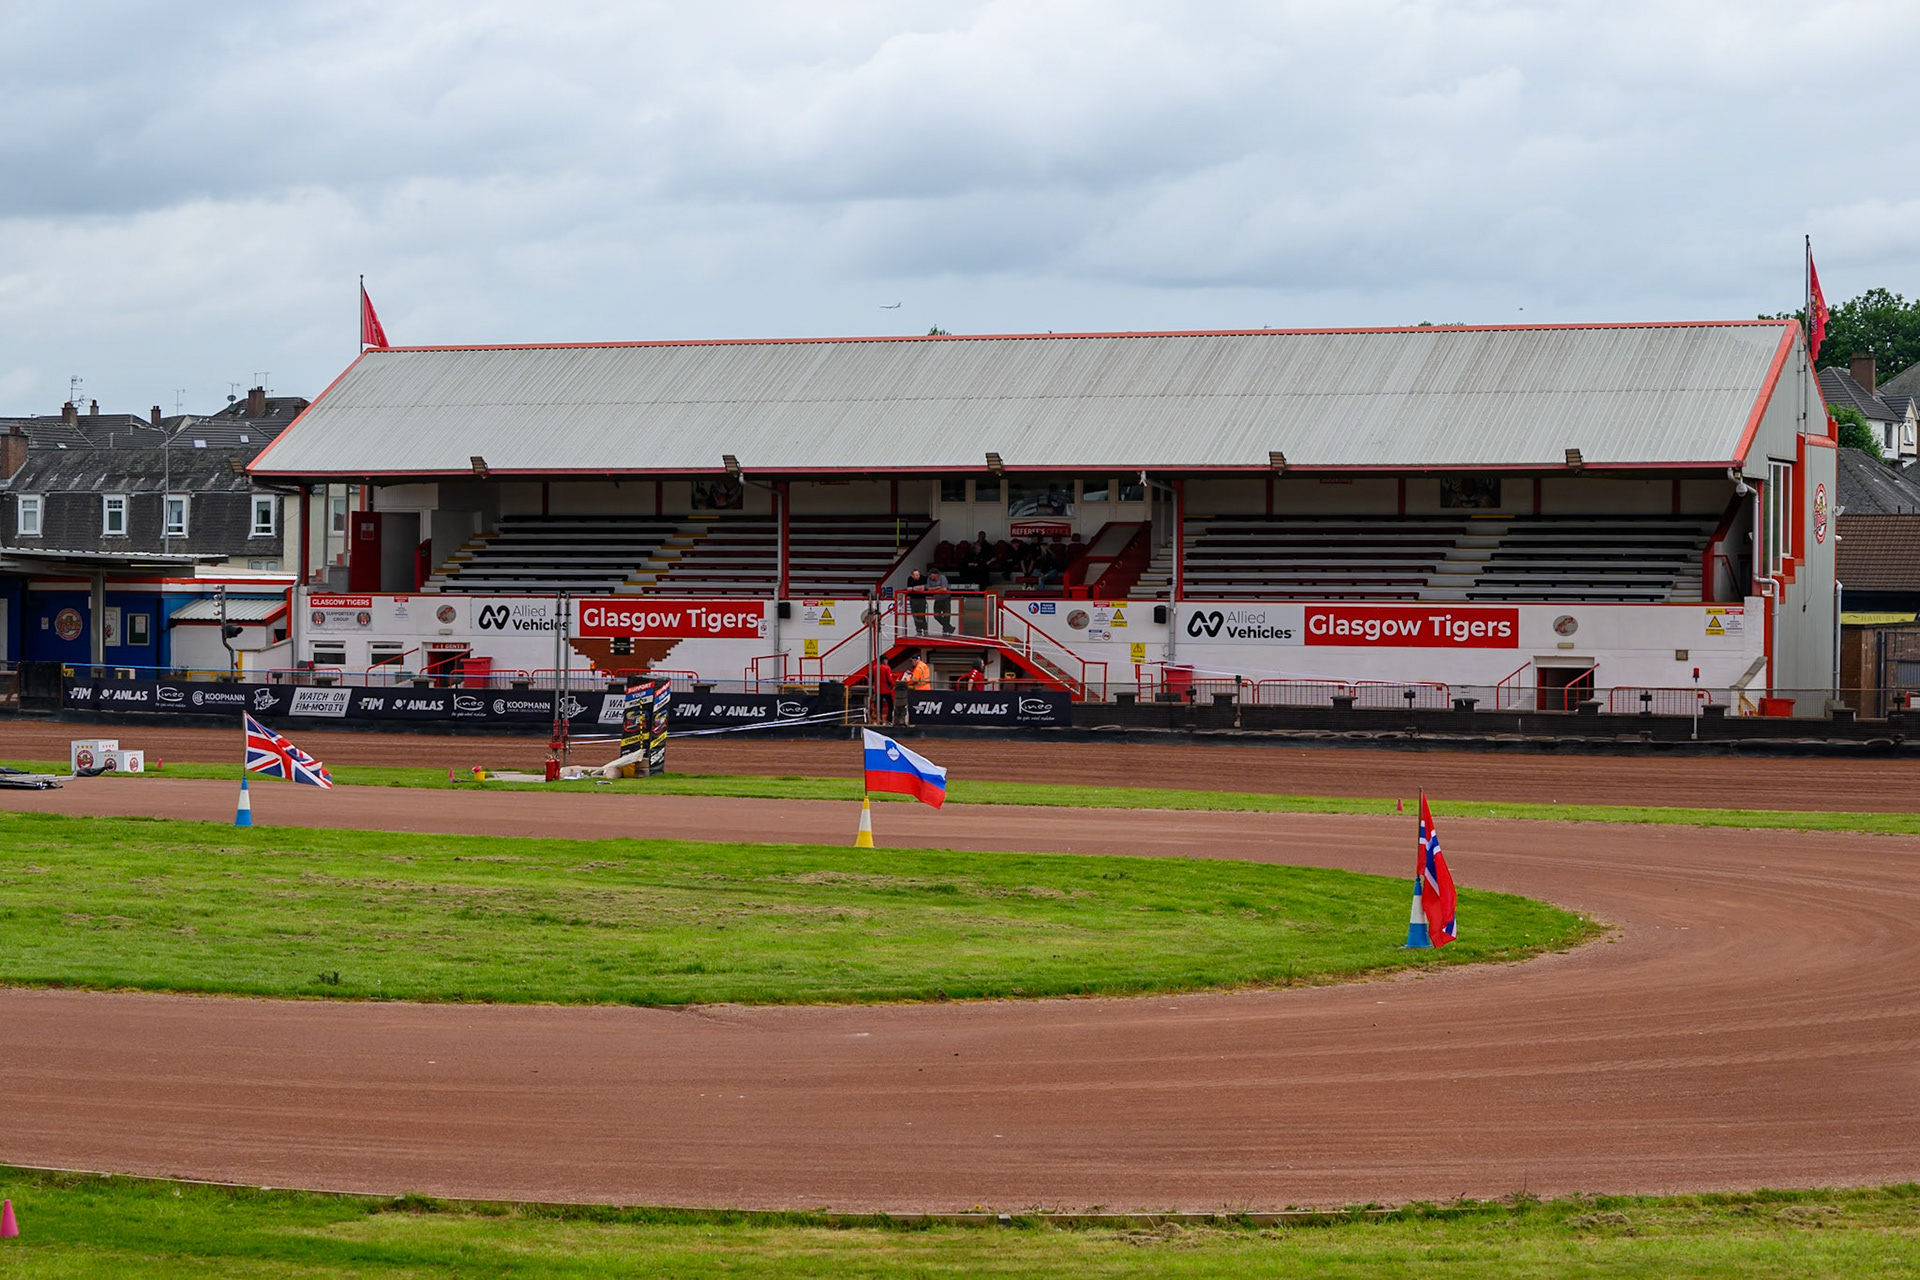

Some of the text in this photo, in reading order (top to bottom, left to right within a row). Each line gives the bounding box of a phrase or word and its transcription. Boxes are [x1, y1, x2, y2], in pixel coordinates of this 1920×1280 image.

[512, 605, 546, 616] Allied
[583, 607, 681, 632] Glasgow
[686, 607, 758, 633] Tigers
[1226, 611, 1265, 623] Allied
[1226, 625, 1292, 638] Vehicles
[1309, 614, 1512, 642] Glasgow Tigers
[69, 687, 92, 699] FIM
[113, 690, 148, 700] ANLAS
[205, 693, 245, 701] KOOPMANN
[299, 692, 346, 701] WATCH ON
[358, 698, 384, 710] FIM
[407, 700, 444, 710] ANLAS
[507, 701, 550, 710] KOOPMANN
[673, 704, 702, 716] FIM
[913, 702, 942, 714] FIM
[967, 703, 1008, 715] ANLAS
[726, 706, 766, 716] ANLAS
